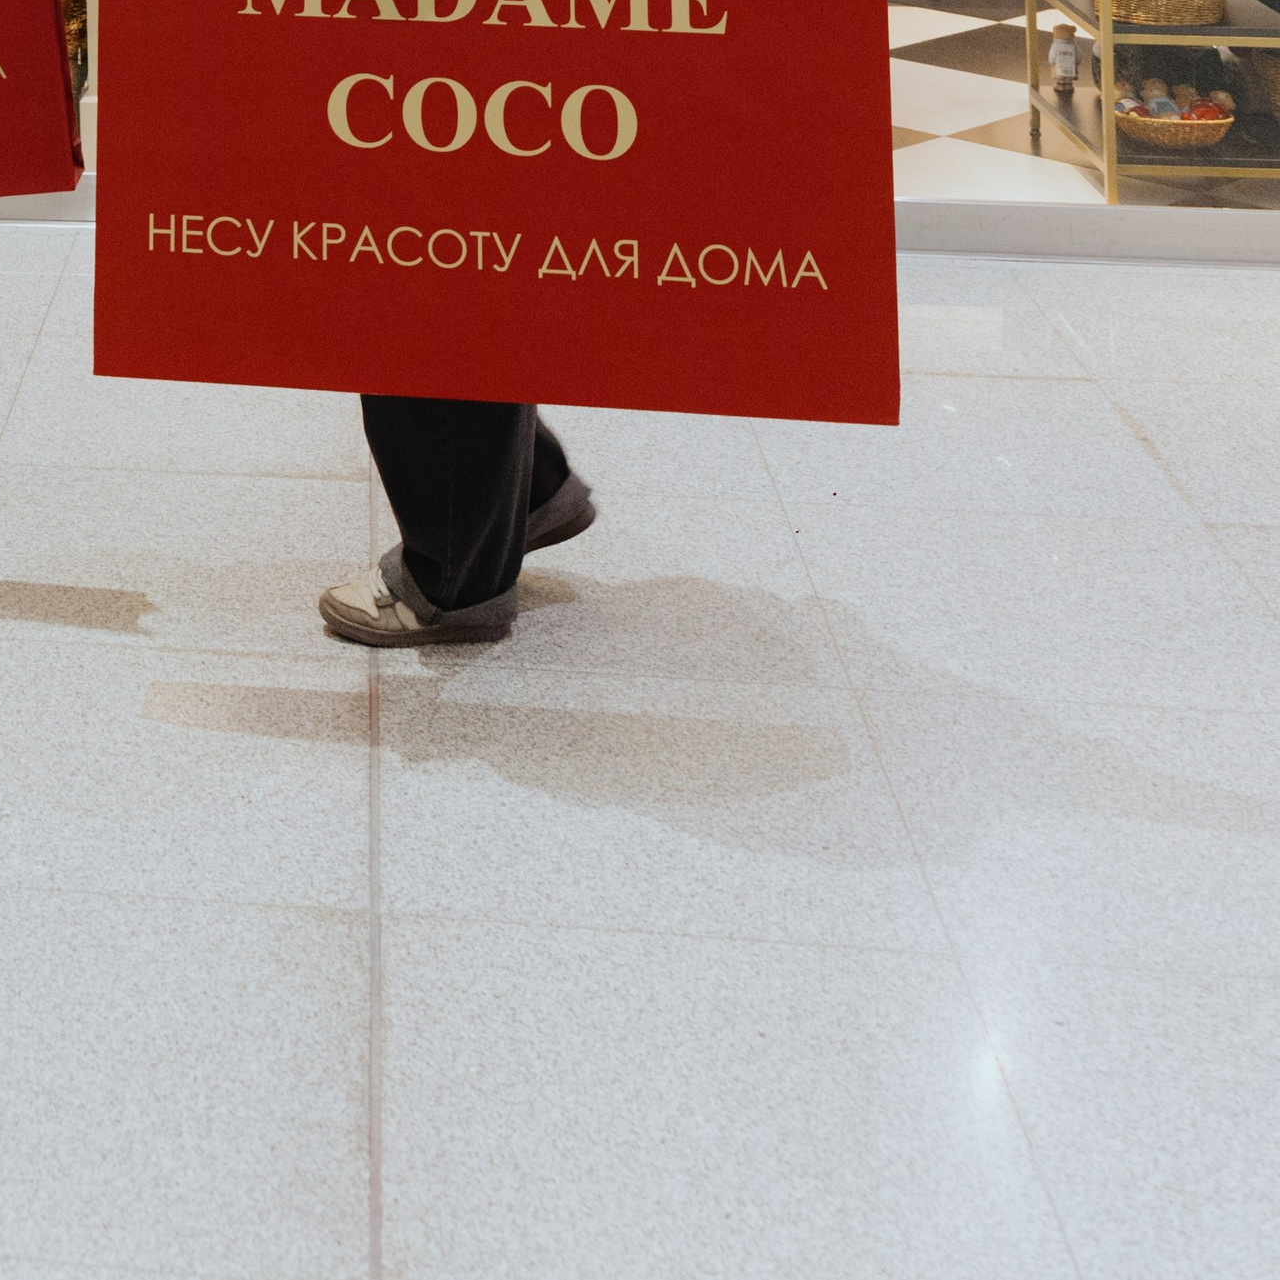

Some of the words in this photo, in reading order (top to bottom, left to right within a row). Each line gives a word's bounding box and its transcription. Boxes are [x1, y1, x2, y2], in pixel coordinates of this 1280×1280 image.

[328, 73, 638, 161] COCO
[149, 213, 275, 258] НЕСУ
[294, 221, 522, 272] КРАСОТУ
[539, 236, 639, 281] ДЛЯ
[658, 243, 829, 290] ДОМА
